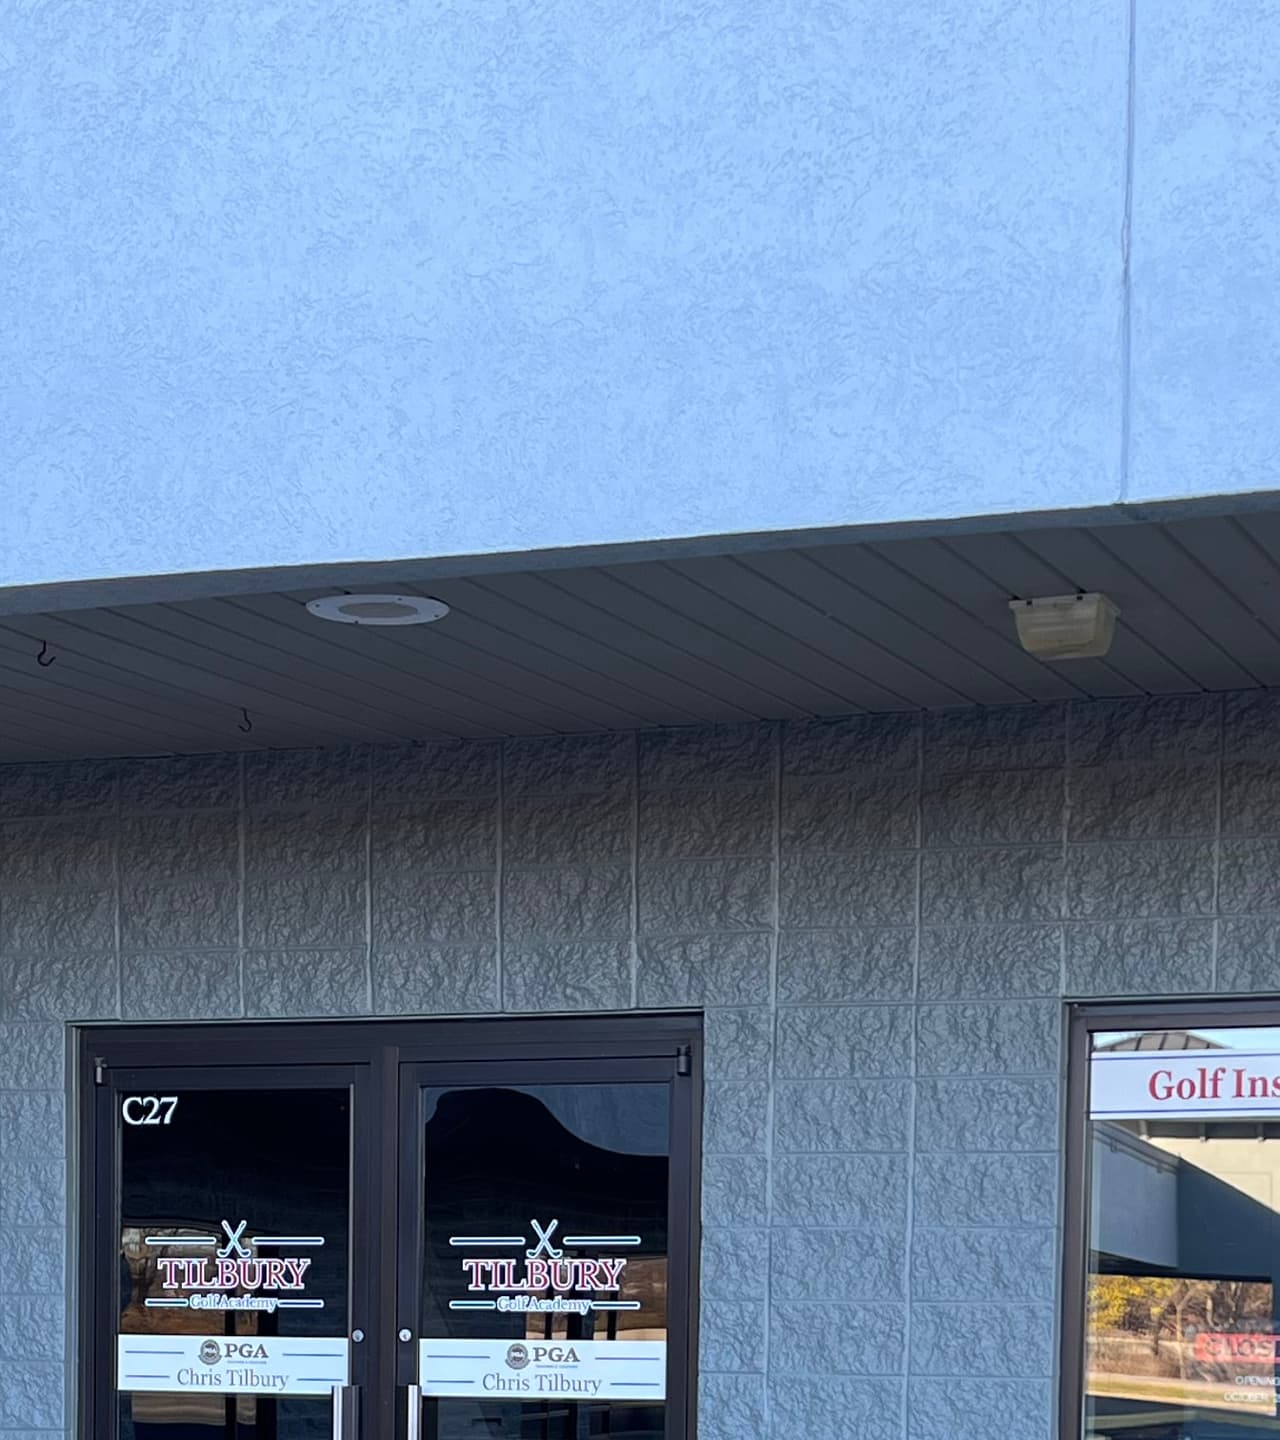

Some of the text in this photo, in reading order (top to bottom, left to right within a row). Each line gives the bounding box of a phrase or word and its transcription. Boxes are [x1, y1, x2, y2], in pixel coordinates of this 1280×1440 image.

[1148, 1067, 1226, 1100] Golf
[122, 1096, 179, 1126] C27
[157, 1258, 311, 1290] TILBURY
[463, 1258, 627, 1291] TILBURY
[190, 1294, 279, 1314] Golf Academy
[497, 1296, 592, 1316] Golf Academy
[224, 1343, 269, 1358] PGA
[533, 1347, 581, 1363] PGA
[177, 1369, 290, 1391] Chris Tilbury
[482, 1373, 602, 1395] Chris Tilbury
